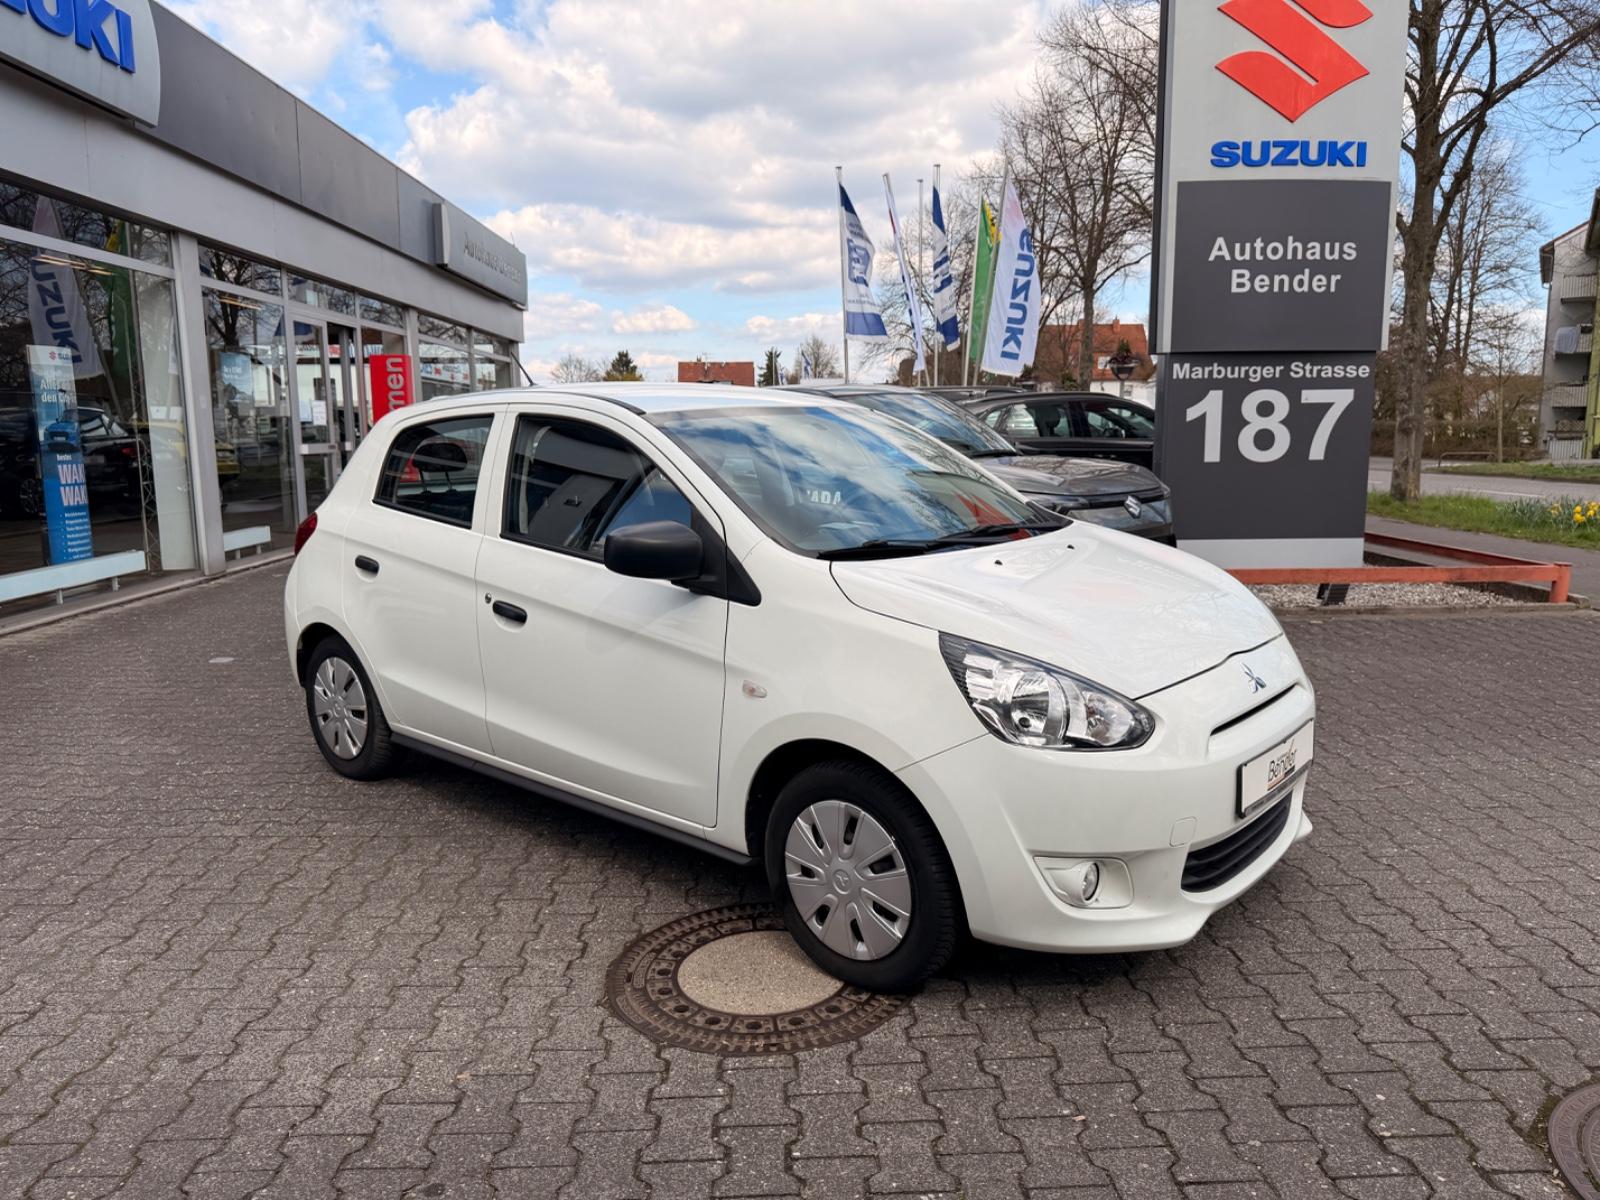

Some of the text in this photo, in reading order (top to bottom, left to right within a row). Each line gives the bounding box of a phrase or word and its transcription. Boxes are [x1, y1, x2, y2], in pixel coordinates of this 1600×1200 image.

[0, 0, 136, 74] UKI
[1210, 140, 1367, 168] SUZUKI
[1208, 235, 1358, 262] Autohaus
[1230, 268, 1342, 293] Bender
[31, 249, 83, 363] UZUKI
[1172, 361, 1370, 382] Marburger Strasse
[1185, 388, 1355, 463] 187
